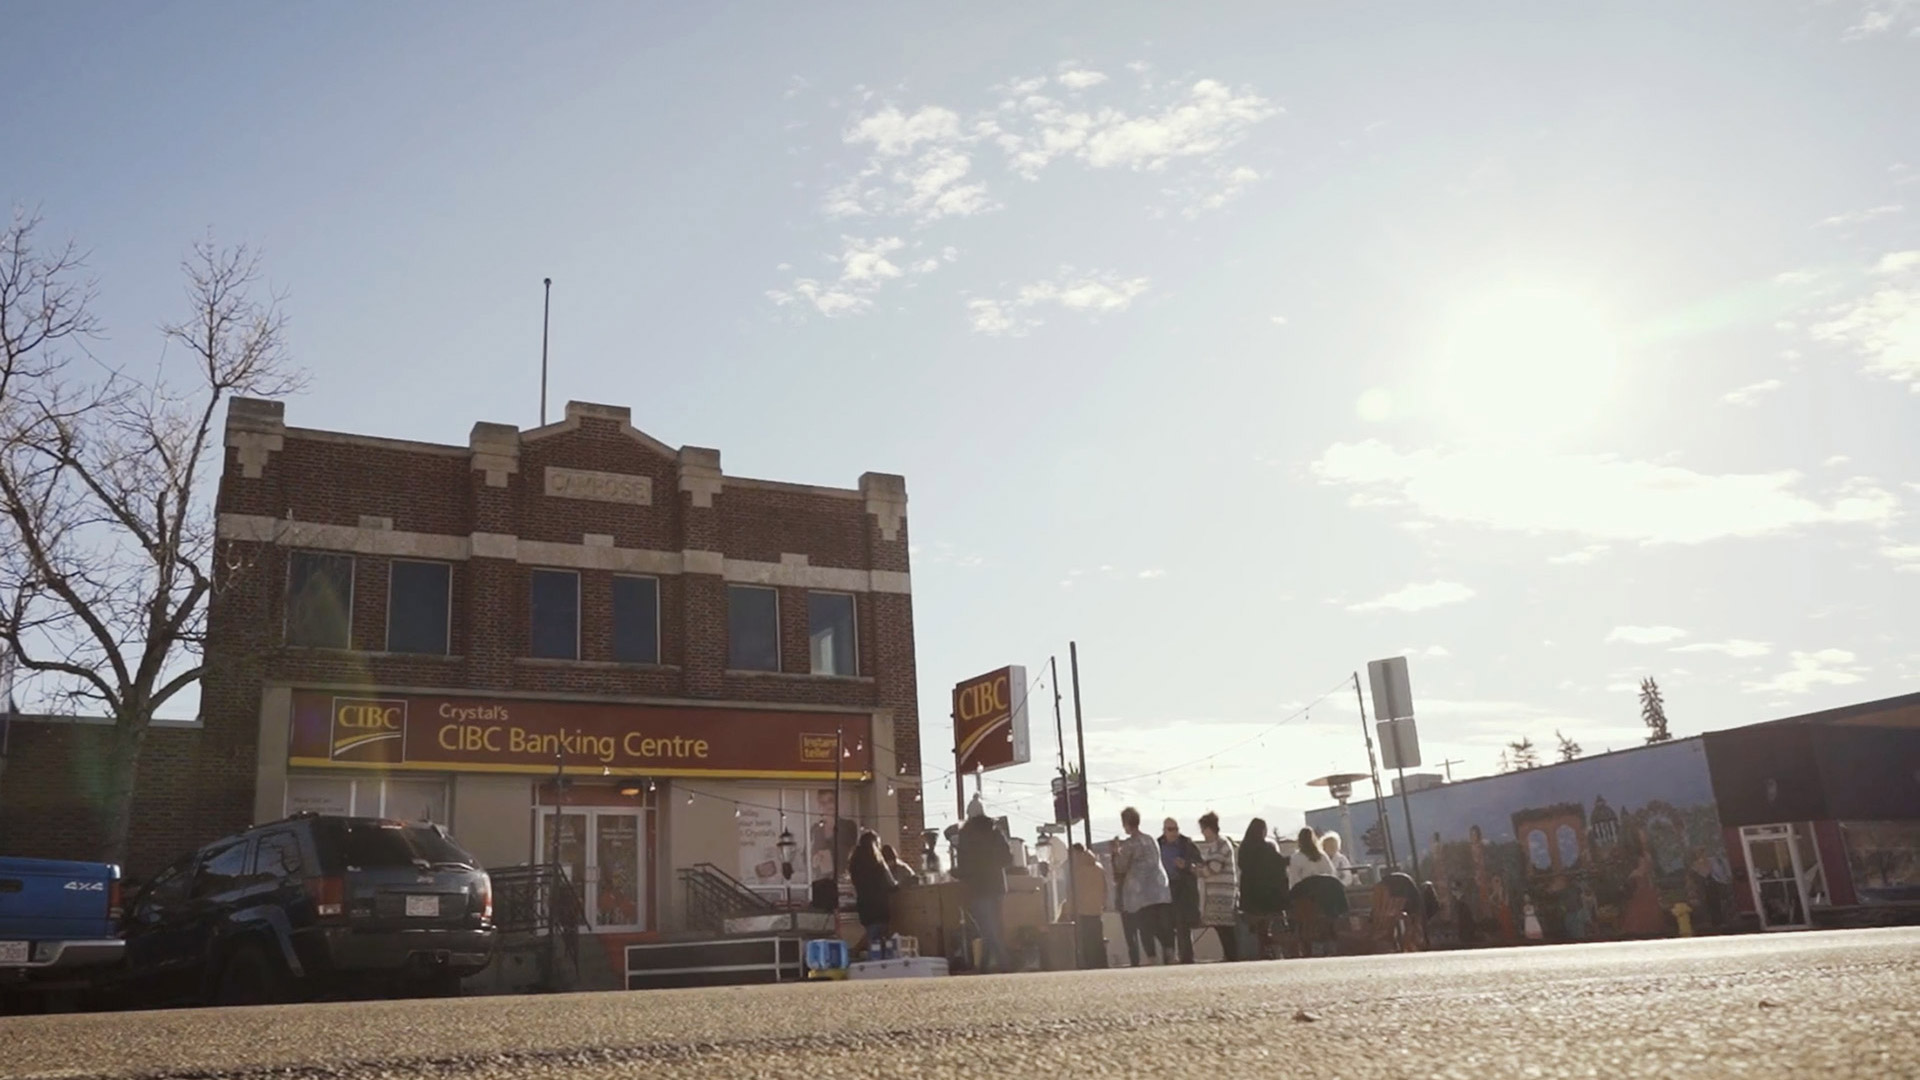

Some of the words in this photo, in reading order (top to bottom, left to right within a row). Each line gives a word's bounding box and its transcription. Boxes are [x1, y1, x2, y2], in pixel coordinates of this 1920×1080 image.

[438, 703, 509, 722] Crystal's
[959, 676, 1007, 720] CIBC
[338, 705, 400, 729] CIBC
[438, 724, 501, 752] CIBC
[509, 728, 615, 762] Banking
[623, 731, 709, 758] Centre
